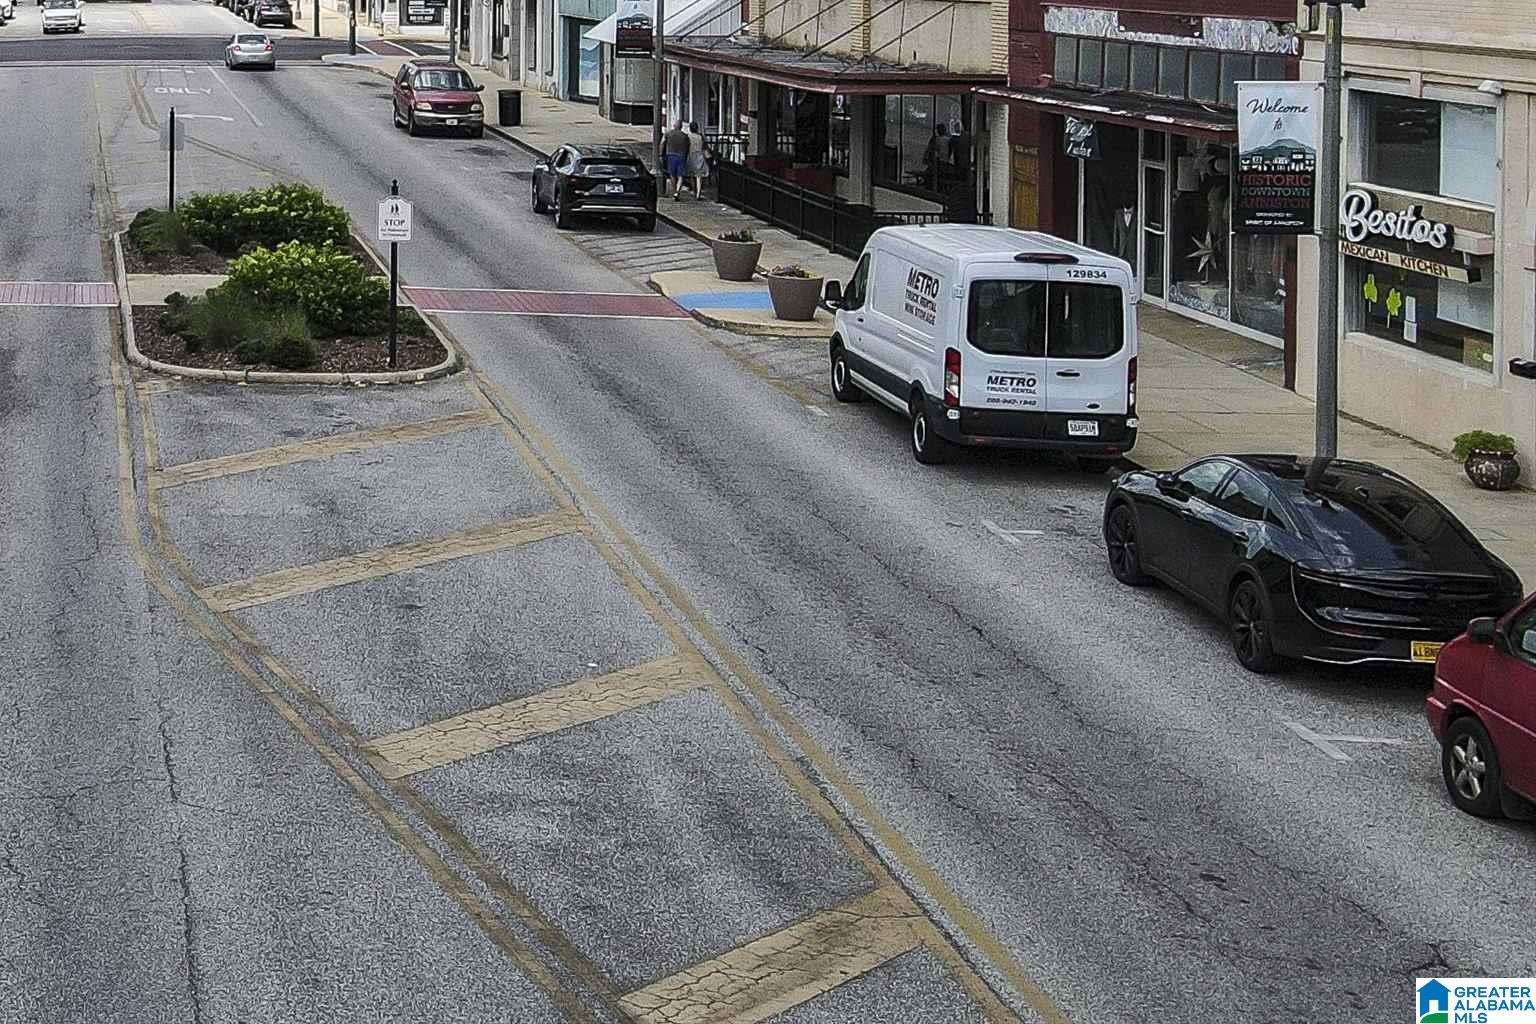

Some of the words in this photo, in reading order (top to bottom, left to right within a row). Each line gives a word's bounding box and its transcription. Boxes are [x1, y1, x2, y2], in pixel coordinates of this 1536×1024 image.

[154, 87, 211, 95] ONLY
[1246, 97, 1309, 114] Welcome
[1273, 117, 1283, 131] to
[1240, 174, 1312, 187] HISTORIC
[1340, 189, 1447, 249] Besitos
[1343, 241, 1389, 263] MEXICAN
[1400, 256, 1449, 277] KITCHEN
[1066, 270, 1107, 279] 129834
[906, 267, 939, 298] METRO
[986, 376, 1037, 387] METRO
